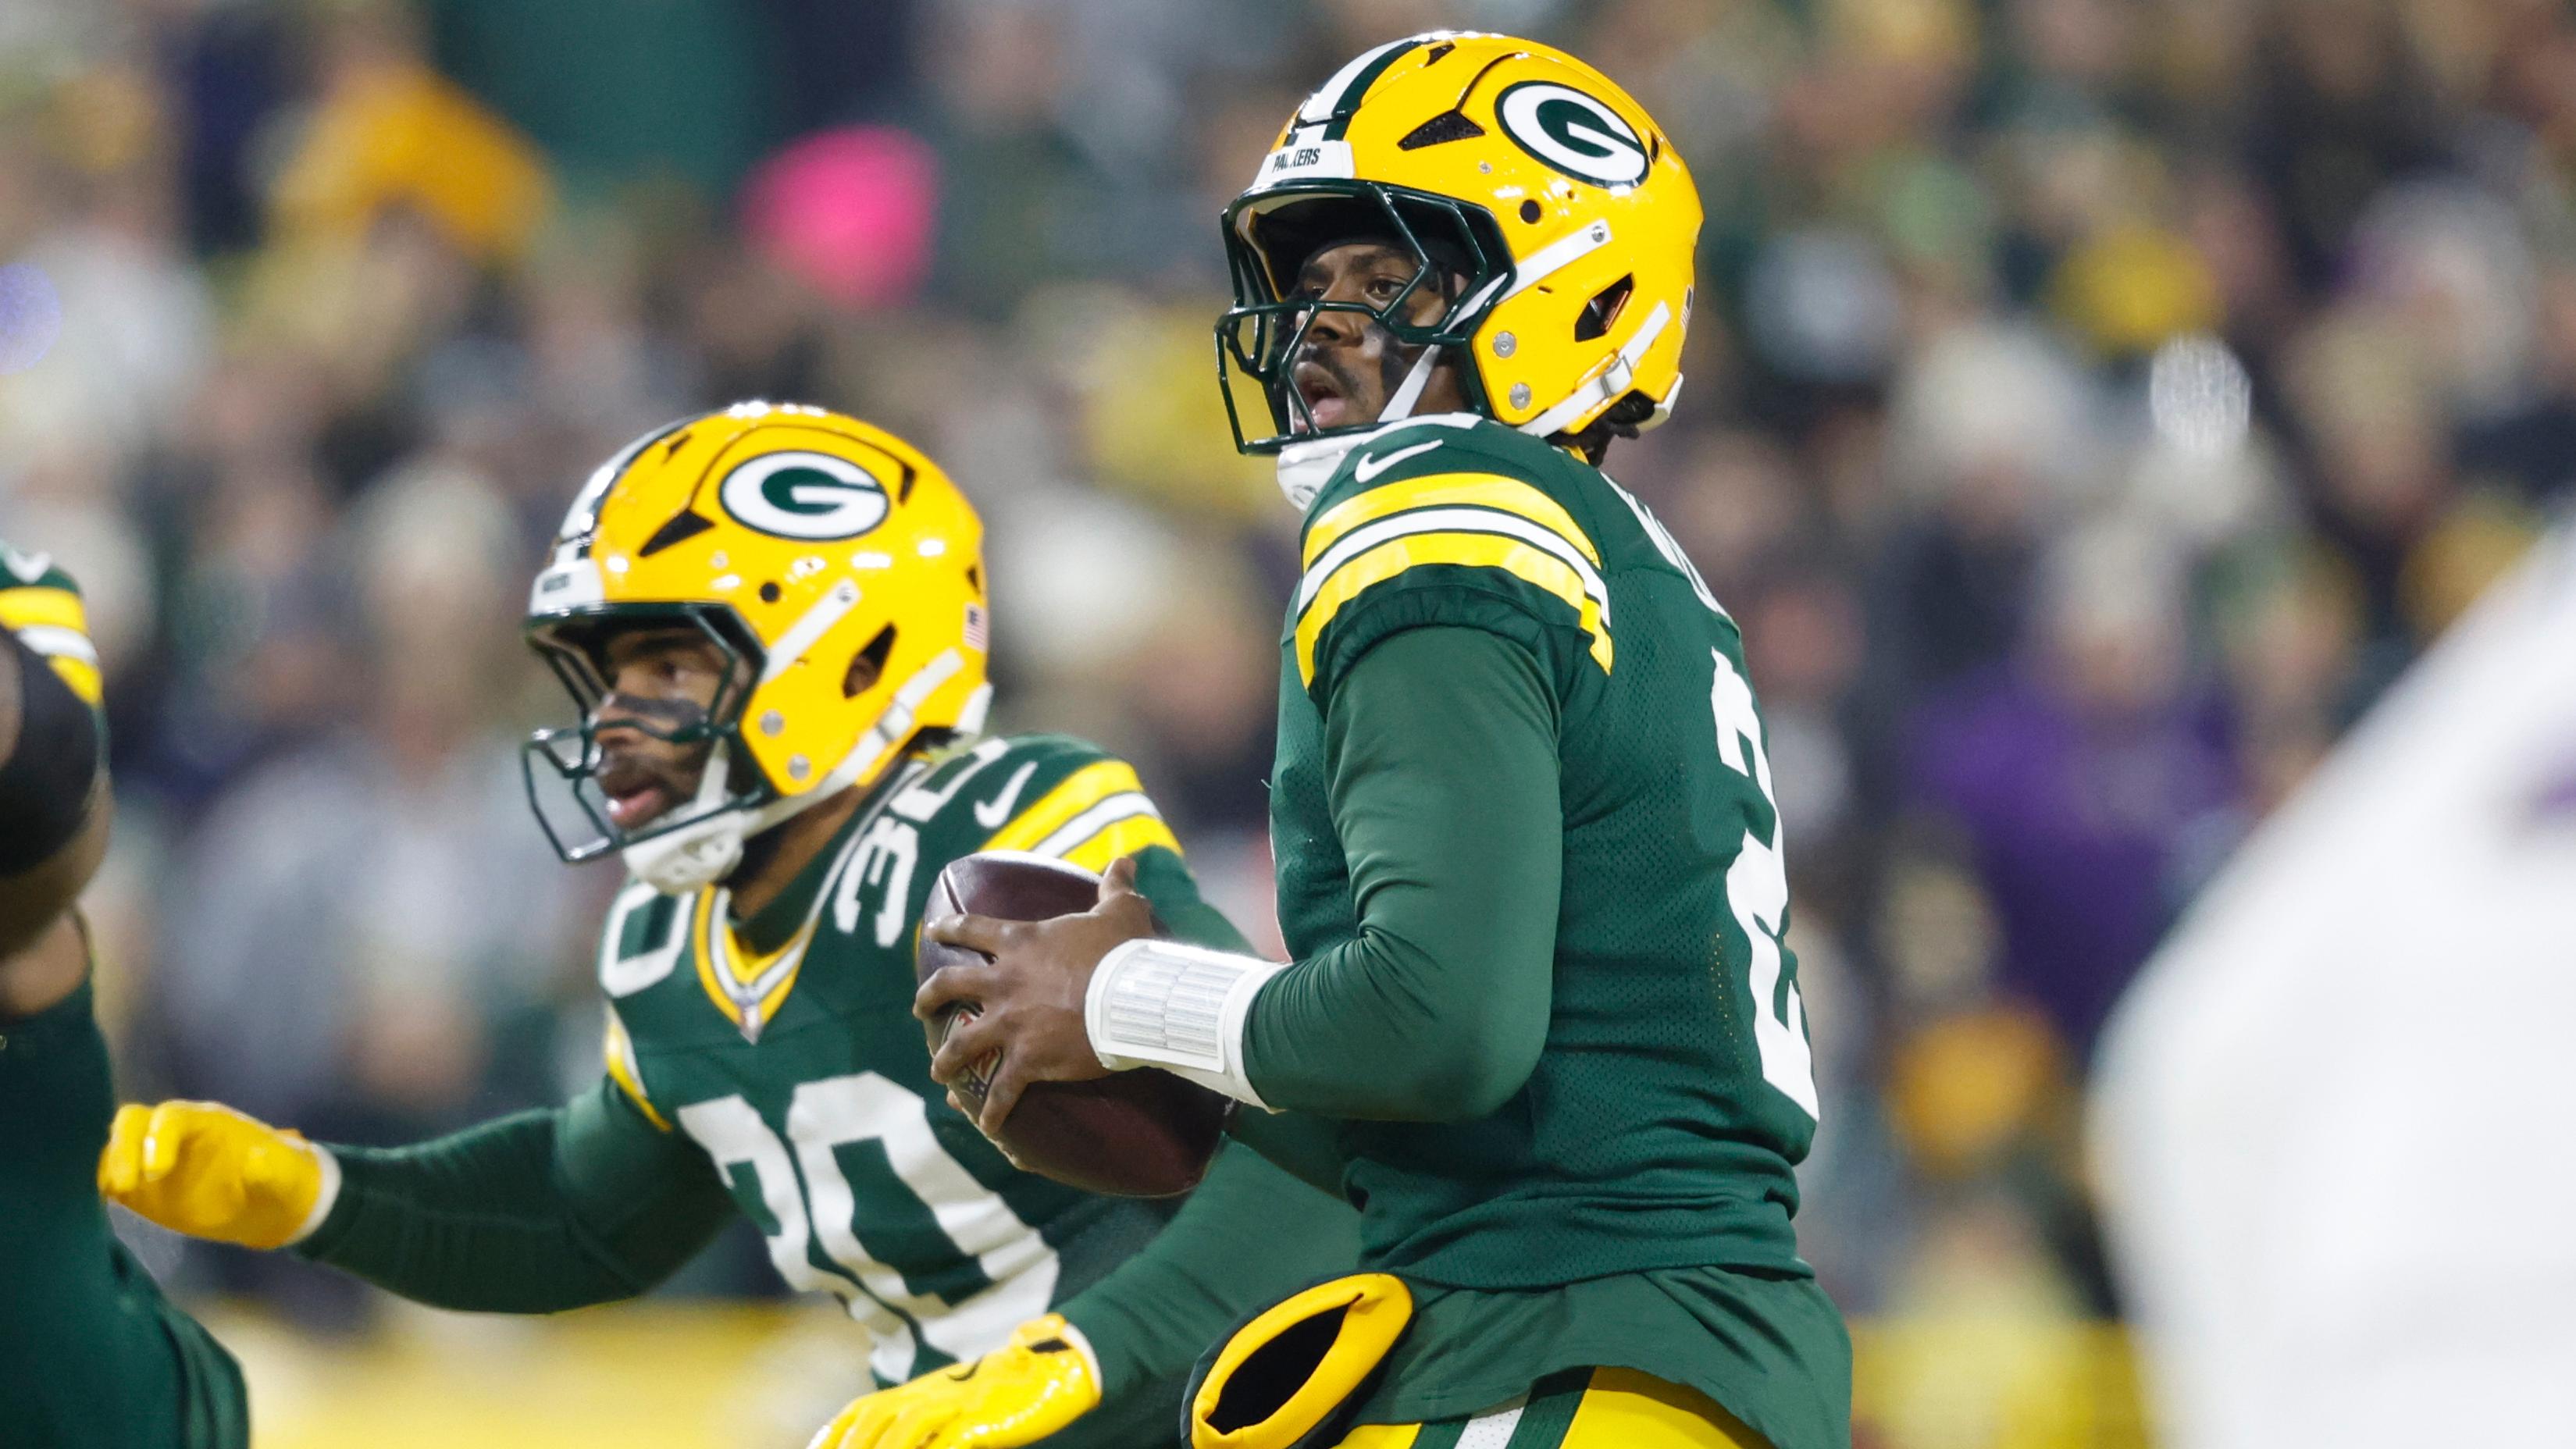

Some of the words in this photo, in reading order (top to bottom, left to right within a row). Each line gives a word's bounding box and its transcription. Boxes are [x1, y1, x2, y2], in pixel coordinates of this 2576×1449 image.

[1495, 80, 1649, 189] G
[719, 450, 889, 541] G
[1711, 646, 1819, 1122] 2
[678, 1070, 1060, 1385] 30
